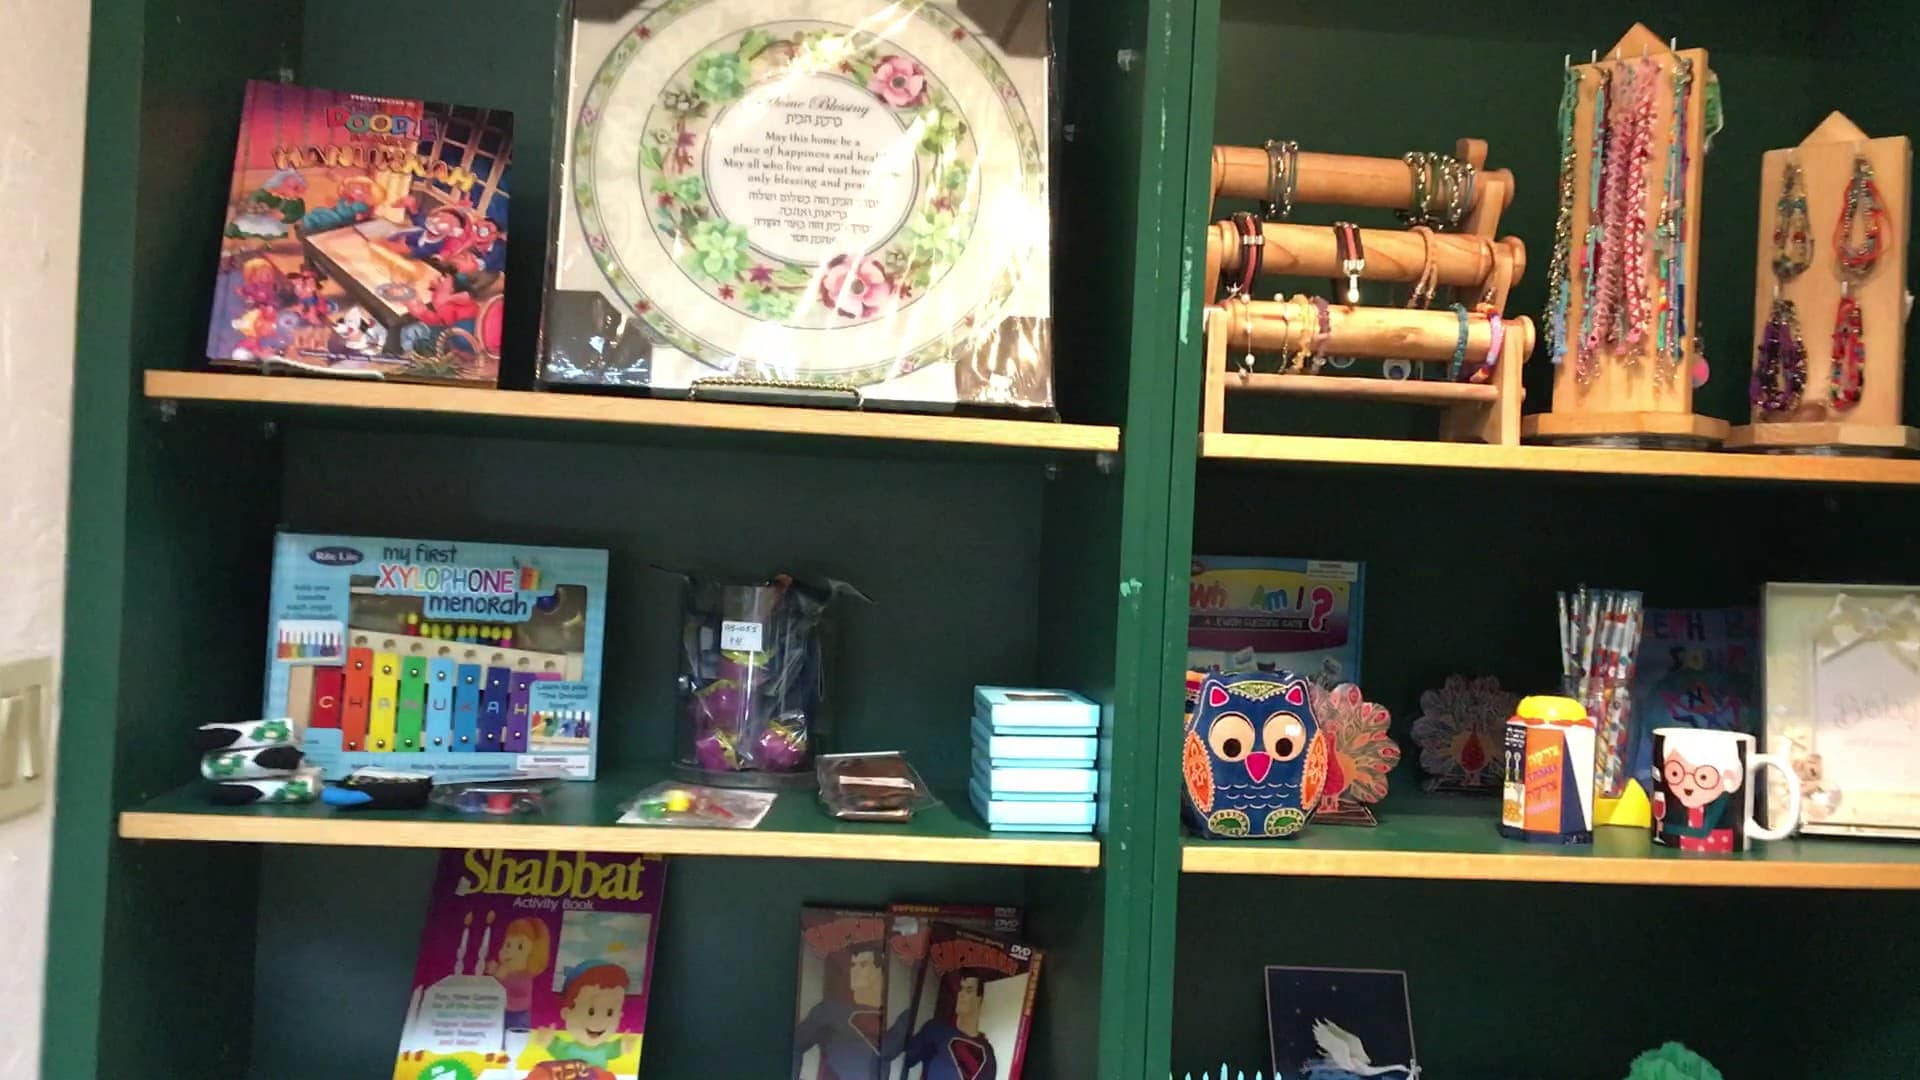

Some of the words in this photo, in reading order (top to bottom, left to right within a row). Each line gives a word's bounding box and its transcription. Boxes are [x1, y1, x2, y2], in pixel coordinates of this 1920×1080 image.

[765, 131, 787, 144] May
[789, 133, 809, 143] this
[811, 134, 838, 146] home
[840, 135, 852, 147] be
[854, 139, 861, 147] a
[733, 143, 760, 155] place
[763, 145, 776, 158] of
[777, 146, 831, 161] happiness
[833, 150, 854, 161] and
[723, 157, 744, 170] May
[748, 158, 760, 169] all
[763, 159, 783, 170] who
[785, 160, 802, 172] live
[805, 162, 825, 173] and
[828, 164, 847, 175] visit
[747, 174, 771, 185] only
[774, 174, 818, 189] blessing
[821, 178, 841, 188] and
[383, 547, 411, 564] my
[379, 564, 514, 593] XYLOPHONE
[1250, 584, 1288, 612] Am
[455, 848, 645, 900] Shabbat
[512, 897, 559, 912] Activity
[562, 899, 595, 911] Book
[1011, 944, 1032, 957] DVD
